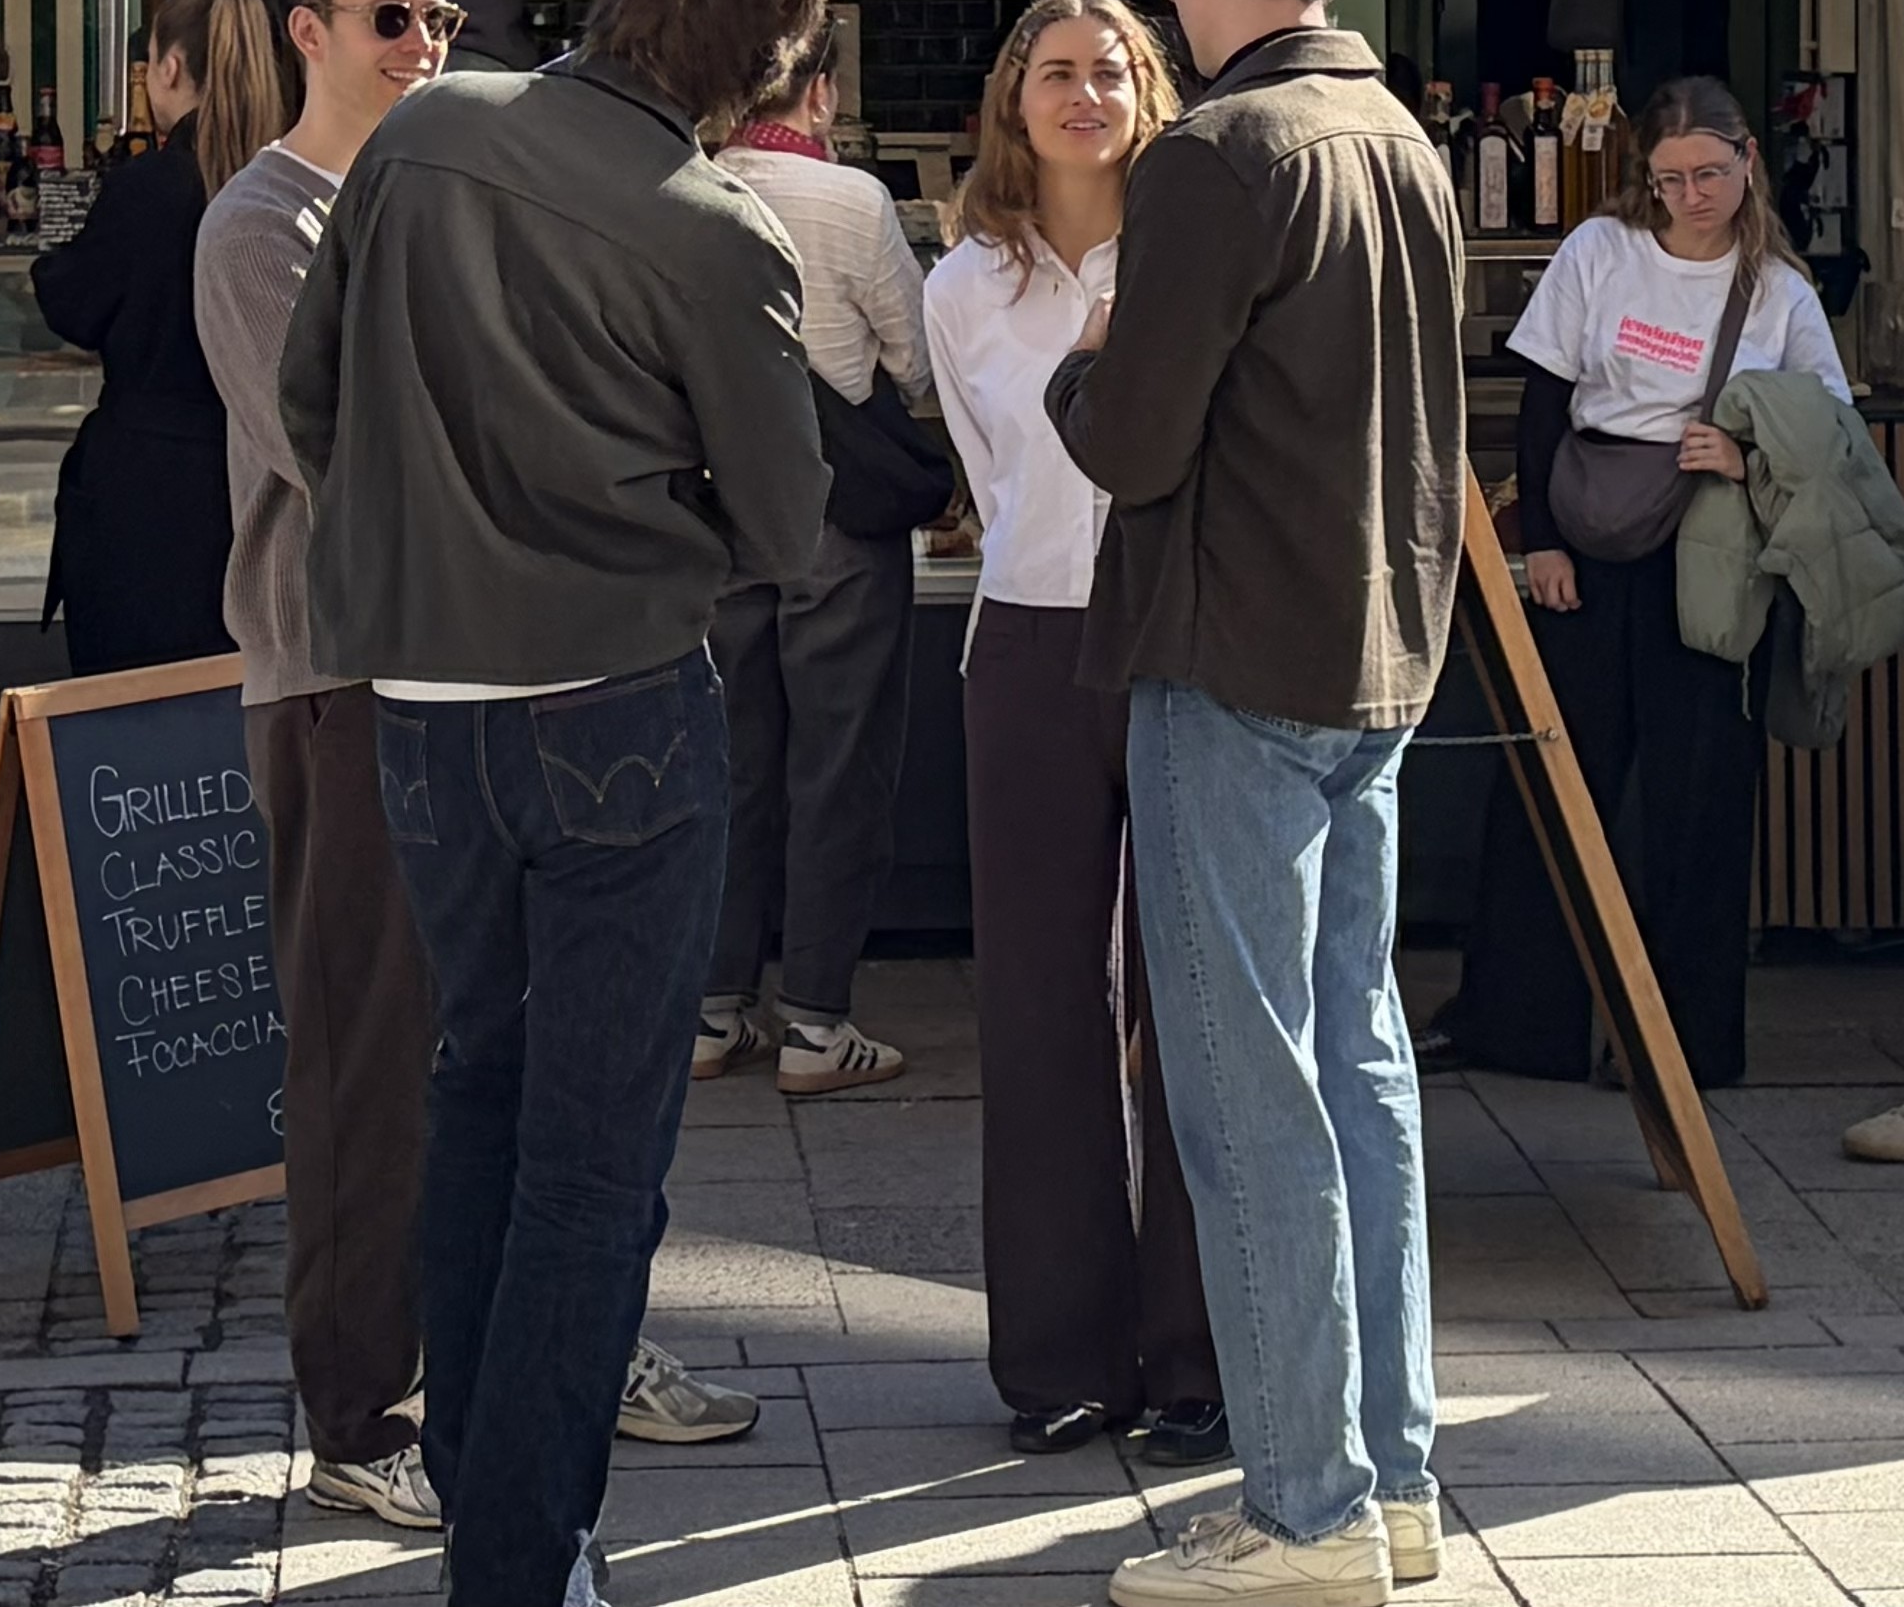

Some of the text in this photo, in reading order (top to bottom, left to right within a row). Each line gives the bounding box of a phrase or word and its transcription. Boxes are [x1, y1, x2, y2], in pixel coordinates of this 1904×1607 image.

[89, 764, 254, 839] GRILLED
[100, 829, 261, 901] CLASSIC
[102, 894, 266, 957] TRUFFLE
[118, 954, 272, 1027] CHEESE
[115, 1010, 288, 1078] FOCACCIA
